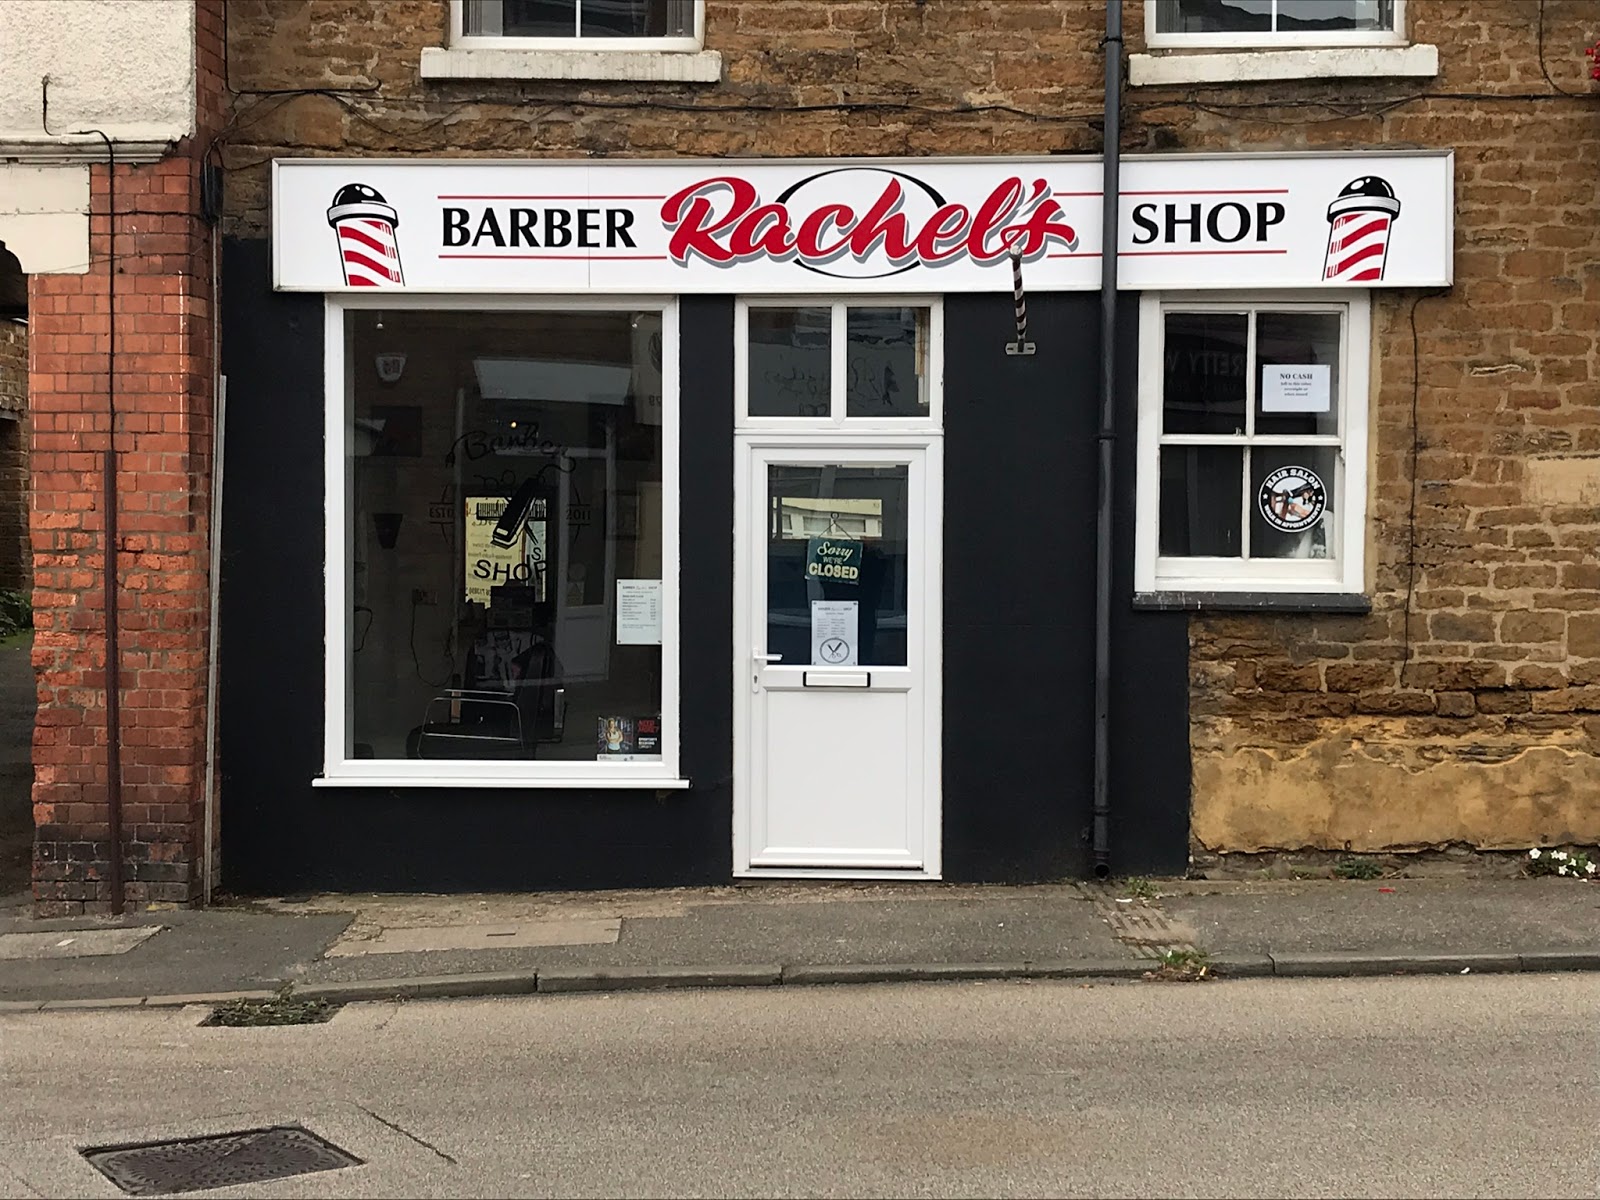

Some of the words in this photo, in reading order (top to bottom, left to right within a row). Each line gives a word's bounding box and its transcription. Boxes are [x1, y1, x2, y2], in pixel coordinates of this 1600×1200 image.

[442, 207, 637, 248] BARBER
[660, 176, 1079, 268] Rachel's
[1132, 202, 1286, 244] SHOP
[1265, 470, 1289, 489] HAIR
[1289, 469, 1321, 490] SALON
[565, 509, 592, 521] 2011
[817, 541, 854, 562] Sorry
[473, 559, 549, 582] SHOP
[808, 562, 859, 579] CLOSED
